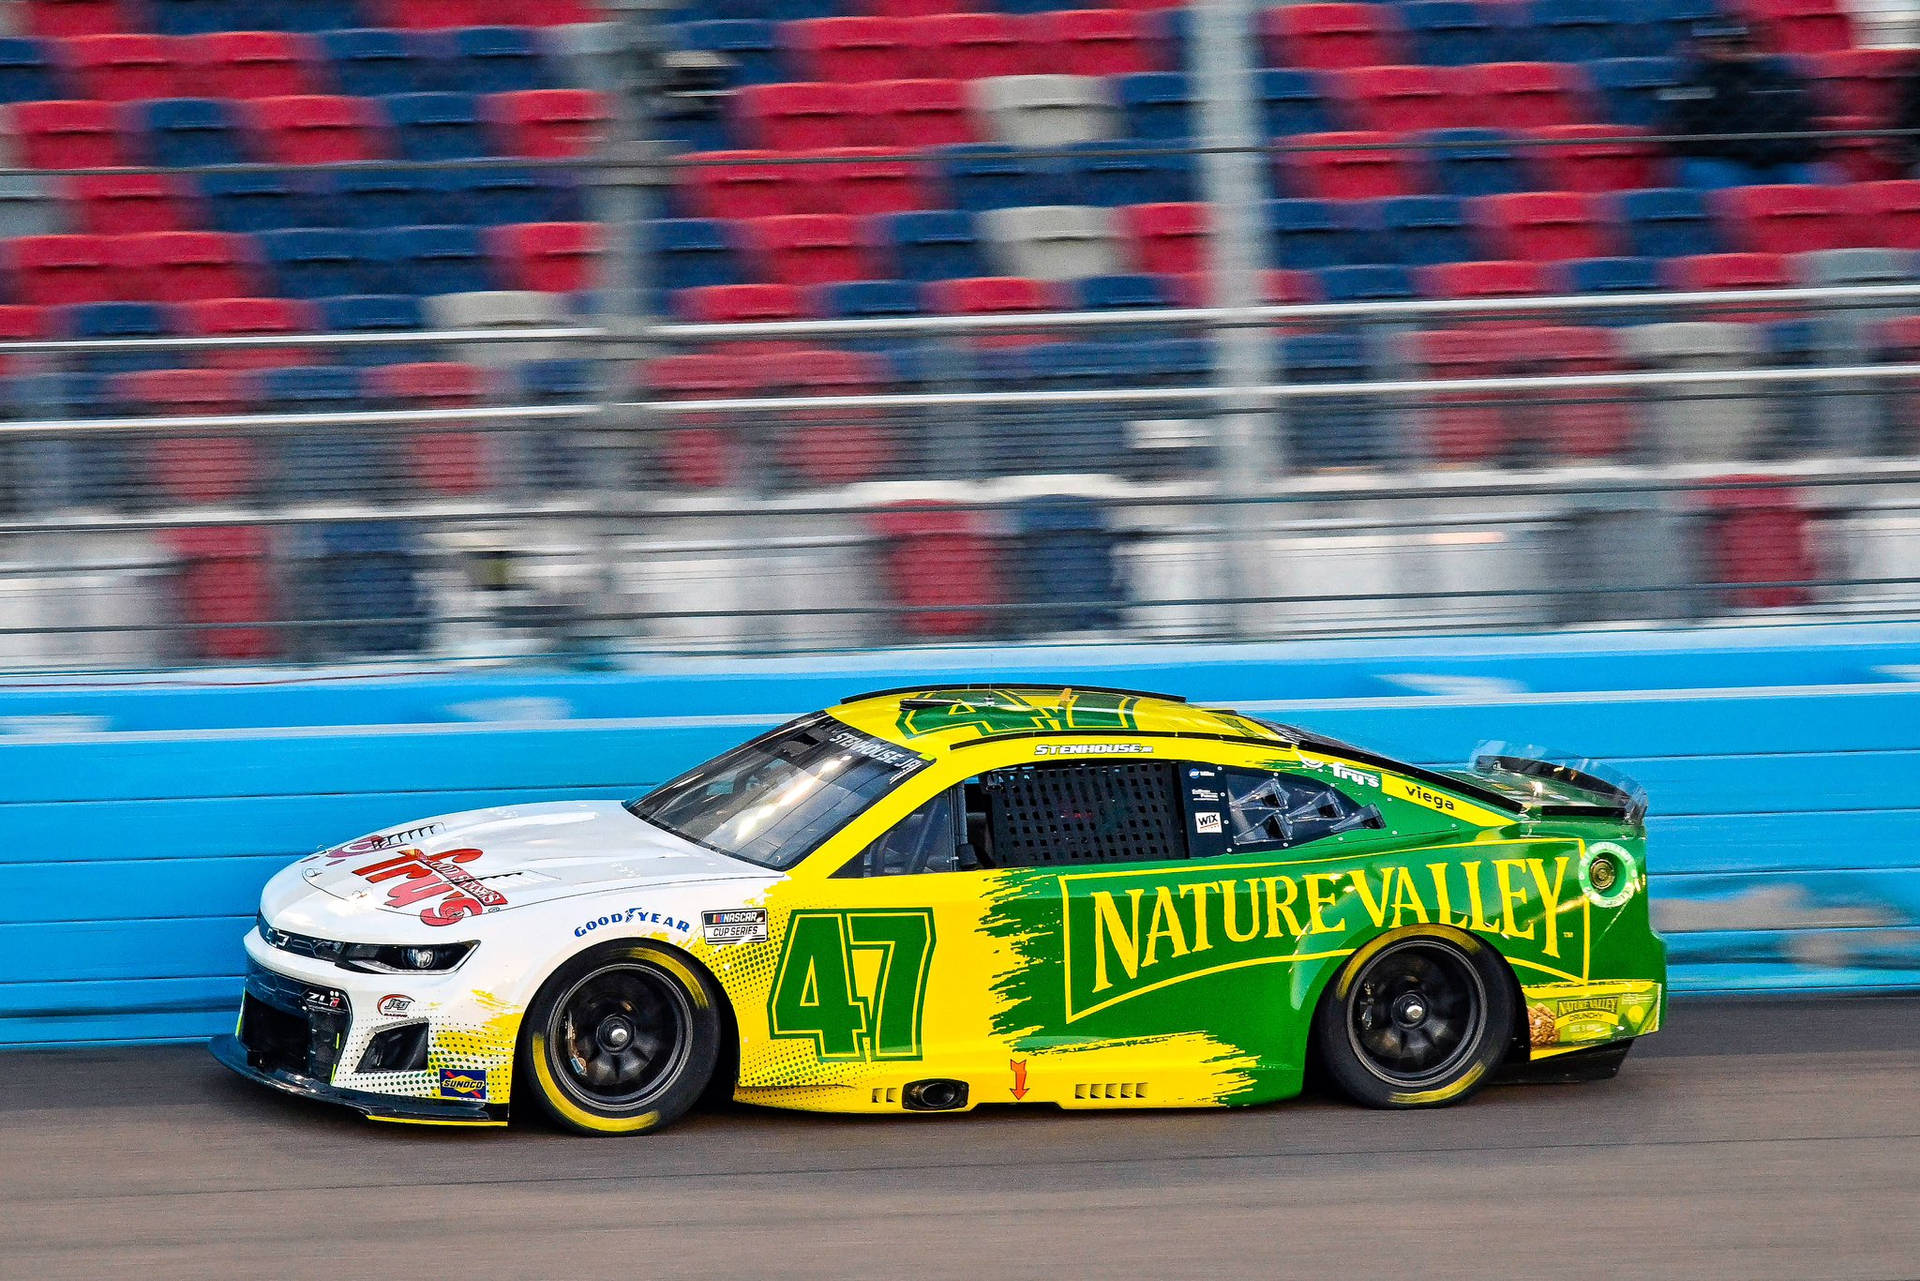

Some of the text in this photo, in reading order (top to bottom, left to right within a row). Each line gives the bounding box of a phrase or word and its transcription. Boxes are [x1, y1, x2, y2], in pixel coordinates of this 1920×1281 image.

[829, 732, 905, 764] STENHOUSE
[1034, 743, 1142, 755] STENHOUSE
[1405, 785, 1455, 811] viega
[1198, 814, 1218, 826] WIX
[724, 912, 758, 924] NASCAR
[1091, 873, 1346, 993] NATURE
[1348, 857, 1570, 958] VALLEY
[713, 926, 758, 937] CUP SERIES
[767, 907, 937, 1063] 47
[443, 1079, 485, 1090] SUNOCO
